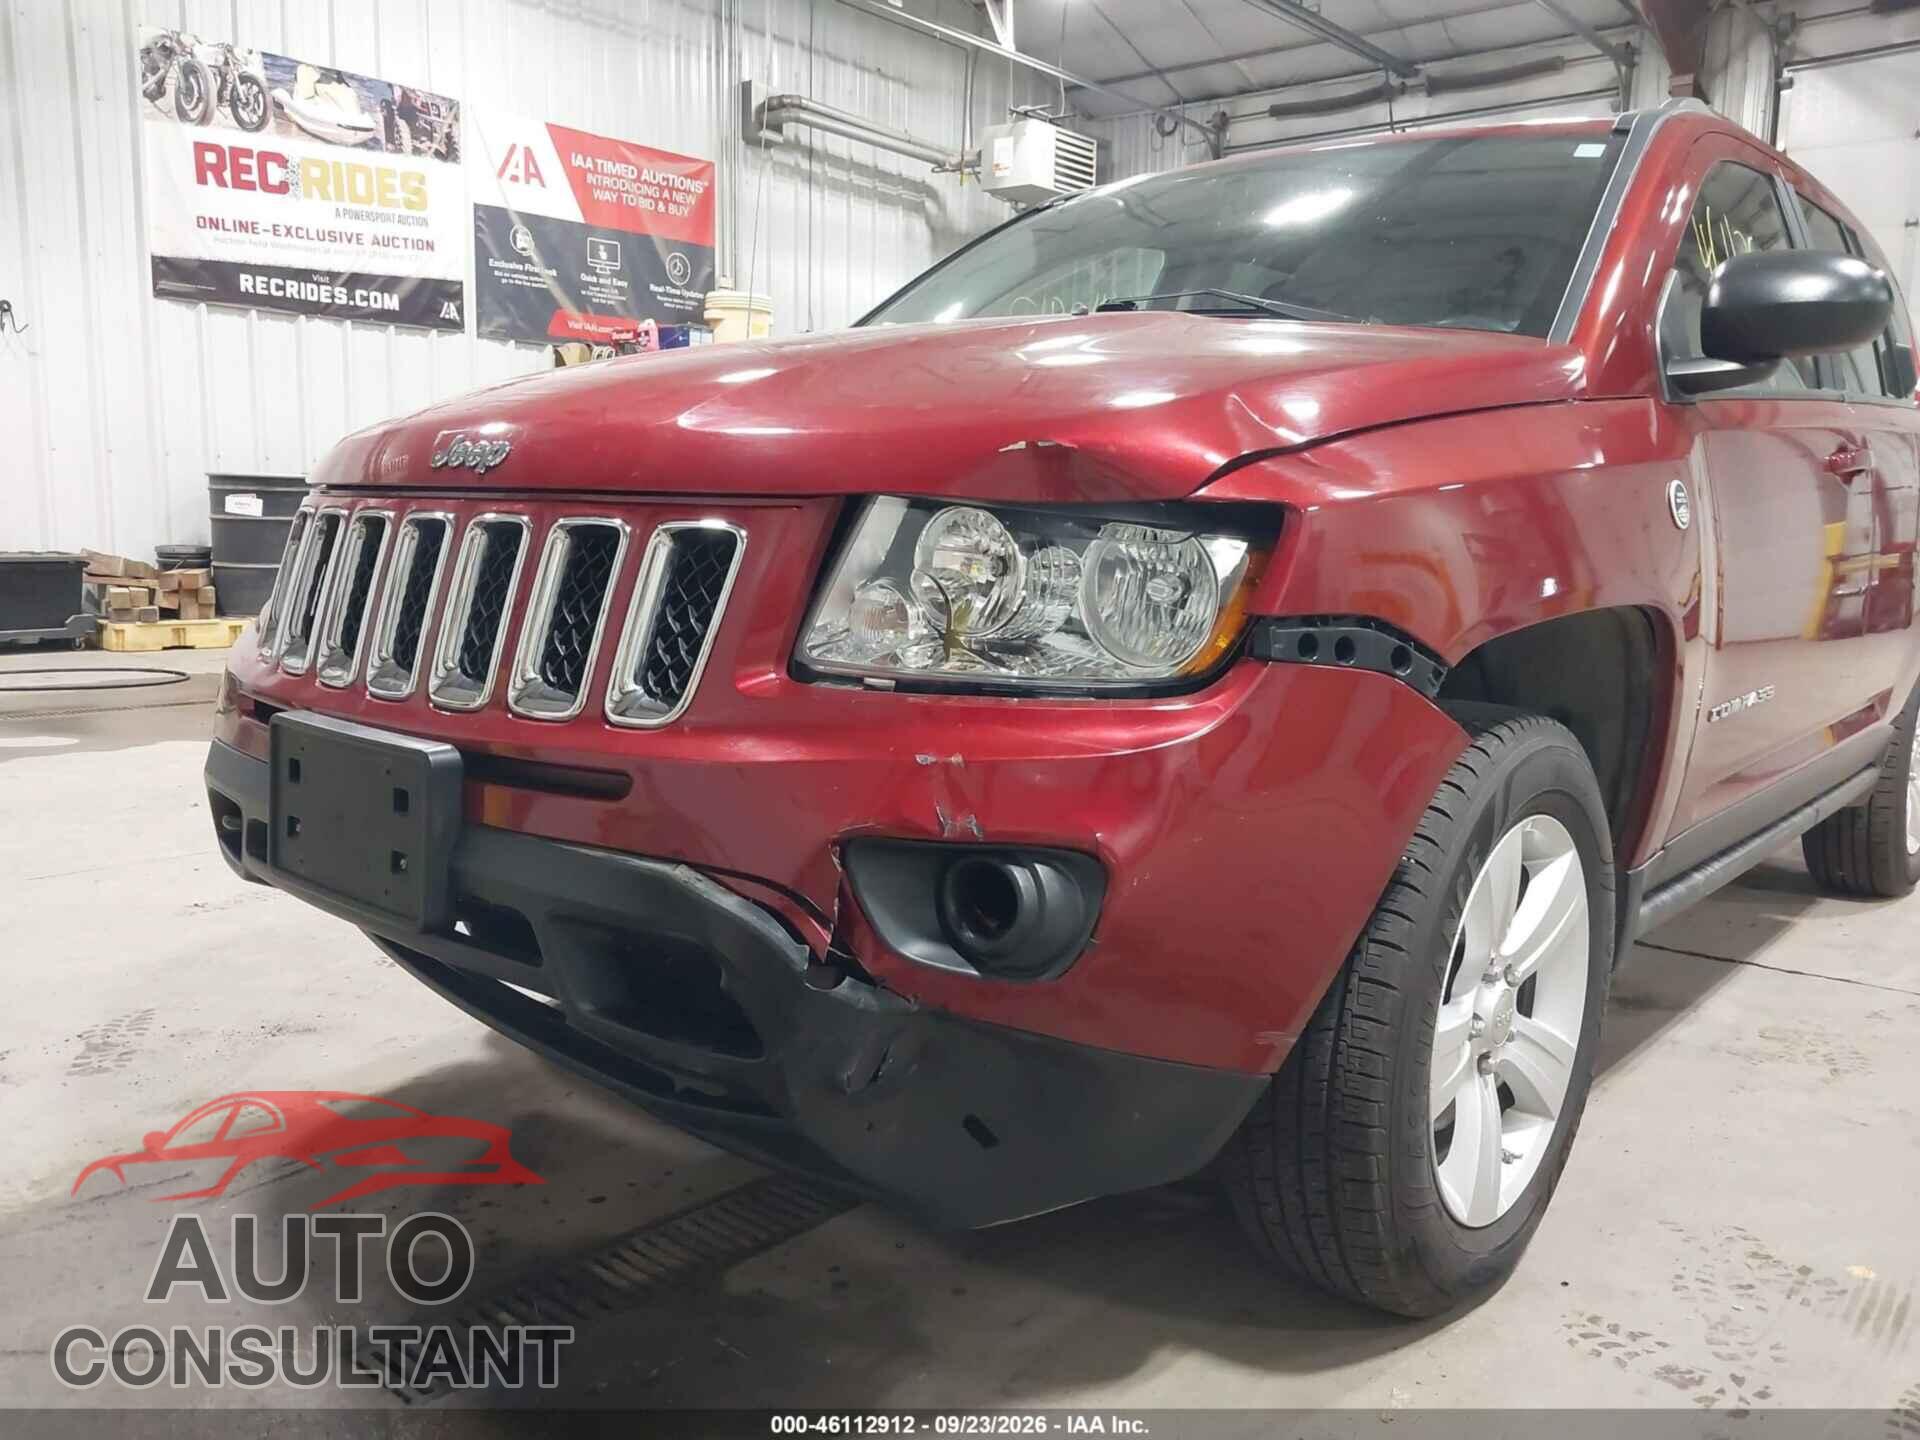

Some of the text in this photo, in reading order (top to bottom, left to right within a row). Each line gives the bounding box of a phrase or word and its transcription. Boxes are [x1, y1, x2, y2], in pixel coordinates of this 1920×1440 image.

[193, 141, 428, 212] REC RIDES
[571, 152, 594, 169] IAA
[594, 157, 637, 179] TIMED
[587, 174, 696, 205] INTRODUCING A NEW
[592, 189, 690, 216] WAY TO BID & BUY
[335, 207, 430, 228] A POWERSPORT AUCTION
[196, 215, 365, 246] ONLINE-EXCLUSIVE
[371, 234, 436, 252] AUCTION
[239, 273, 400, 311] RECRIDES.COM
[312, 273, 330, 284] Visit
[432, 434, 512, 474] Jeep
